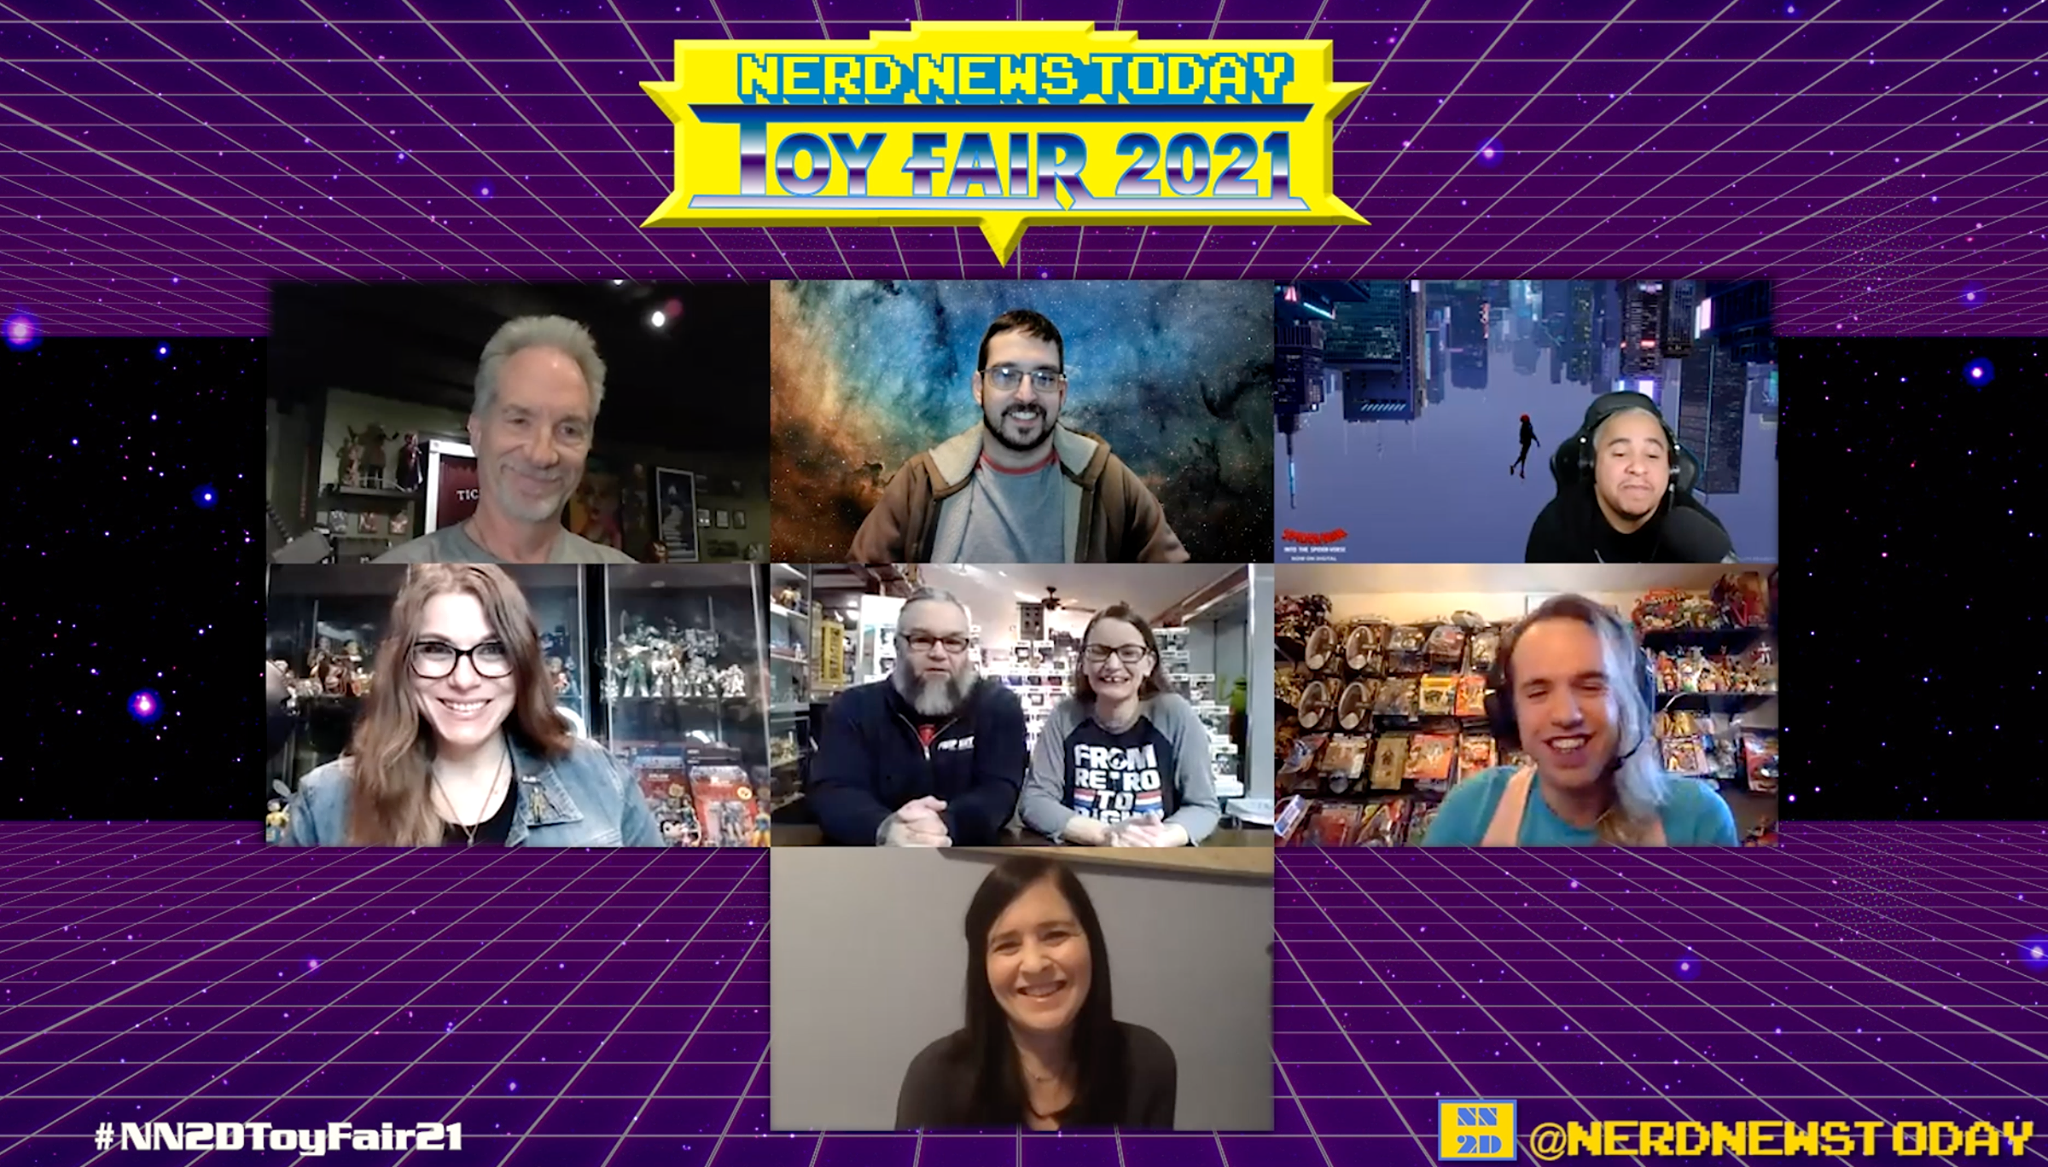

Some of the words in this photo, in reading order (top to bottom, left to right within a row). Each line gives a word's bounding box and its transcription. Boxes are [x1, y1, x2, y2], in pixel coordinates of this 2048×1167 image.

[1074, 743, 1157, 771] FROM
[1075, 767, 1161, 792] RETRO
[1097, 790, 1134, 811] TO
